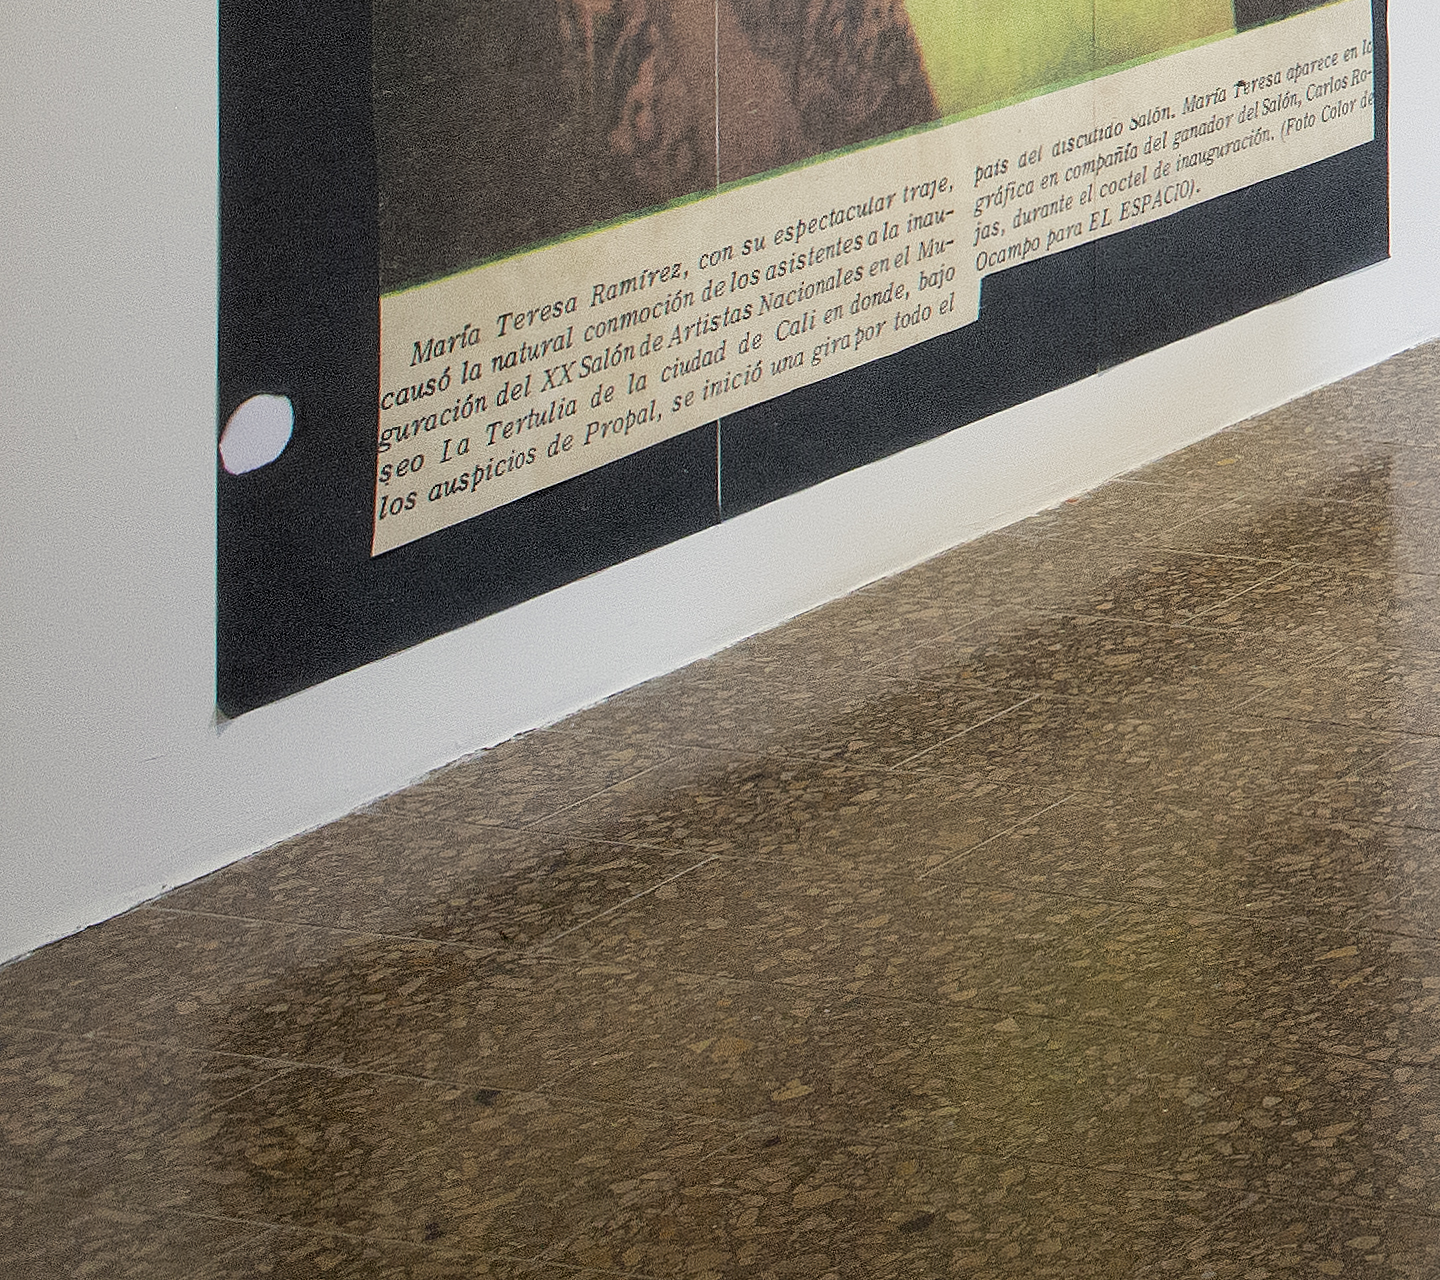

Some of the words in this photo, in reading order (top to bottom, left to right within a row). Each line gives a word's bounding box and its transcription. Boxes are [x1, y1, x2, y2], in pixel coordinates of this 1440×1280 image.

[972, 220, 1006, 247] jas,
[1012, 193, 1074, 229] durante
[1079, 183, 1094, 206] el
[1099, 164, 1148, 199] coctel
[1152, 160, 1172, 180] de
[1176, 127, 1275, 166] inauguración.
[1280, 112, 1316, 144] (Foto
[1321, 98, 1358, 124] Color
[973, 179, 1035, 218] gráfica
[1040, 171, 1059, 190] en
[1064, 142, 1139, 182] compañía
[1143, 130, 1168, 155] del
[1172, 112, 1235, 151] ganador
[1237, 101, 1260, 124] del
[1261, 91, 1303, 117] Salón,
[1306, 75, 1349, 102] Carlos
[1350, 68, 1373, 87] Ro-
[1018, 145, 1043, 169] del
[1181, 87, 1227, 116] María
[1233, 71, 1282, 99] Teresa
[1286, 52, 1339, 83] aparece
[1343, 46, 1358, 63] en
[380, 366, 452, 411] causó
[460, 360, 483, 385] la
[490, 326, 574, 373] natural
[583, 290, 695, 343] conmoción
[700, 279, 726, 303] de
[729, 271, 761, 293] los
[765, 234, 864, 282] asistentes
[867, 230, 878, 246] a
[882, 221, 900, 242] la
[906, 209, 955, 234] inau-
[409, 323, 481, 367] María
[496, 295, 578, 338] Teresa
[589, 262, 689, 308] Ramírez,
[698, 244, 735, 271] con
[741, 236, 767, 256] su
[773, 192, 897, 246] espectacular
[902, 176, 954, 204] traje,
[975, 236, 1041, 272] Ocampo
[1046, 221, 1083, 251] para
[1088, 207, 1113, 232] EL
[1119, 178, 1202, 222] ESPACIO).
[378, 393, 488, 453] guración
[495, 374, 533, 408] del
[541, 360, 577, 394] XX
[578, 342, 636, 380] Salón
[639, 333, 664, 357] de
[667, 303, 753, 349] Artistas
[757, 264, 865, 317] Nacionales
[869, 256, 890, 278] en
[893, 245, 911, 269] el
[916, 238, 955, 262] Mu-
[378, 453, 426, 484] seo
[485, 398, 578, 447] Tertulia
[590, 384, 615, 409] de
[627, 373, 648, 395] la
[661, 339, 727, 383] ciudad
[738, 331, 763, 355] de
[775, 309, 817, 342] Cali
[823, 303, 844, 324] en
[849, 281, 911, 316] donde,
[918, 263, 956, 291] bajo
[378, 491, 418, 521] los
[428, 447, 537, 503] auspicios
[547, 433, 574, 459] de
[583, 399, 662, 446] Propal,
[671, 390, 695, 413] se
[702, 360, 763, 401] inició
[770, 351, 804, 376] una
[811, 333, 851, 367] gira
[854, 319, 887, 352] por
[893, 303, 932, 332] todo
[938, 291, 956, 316] el
